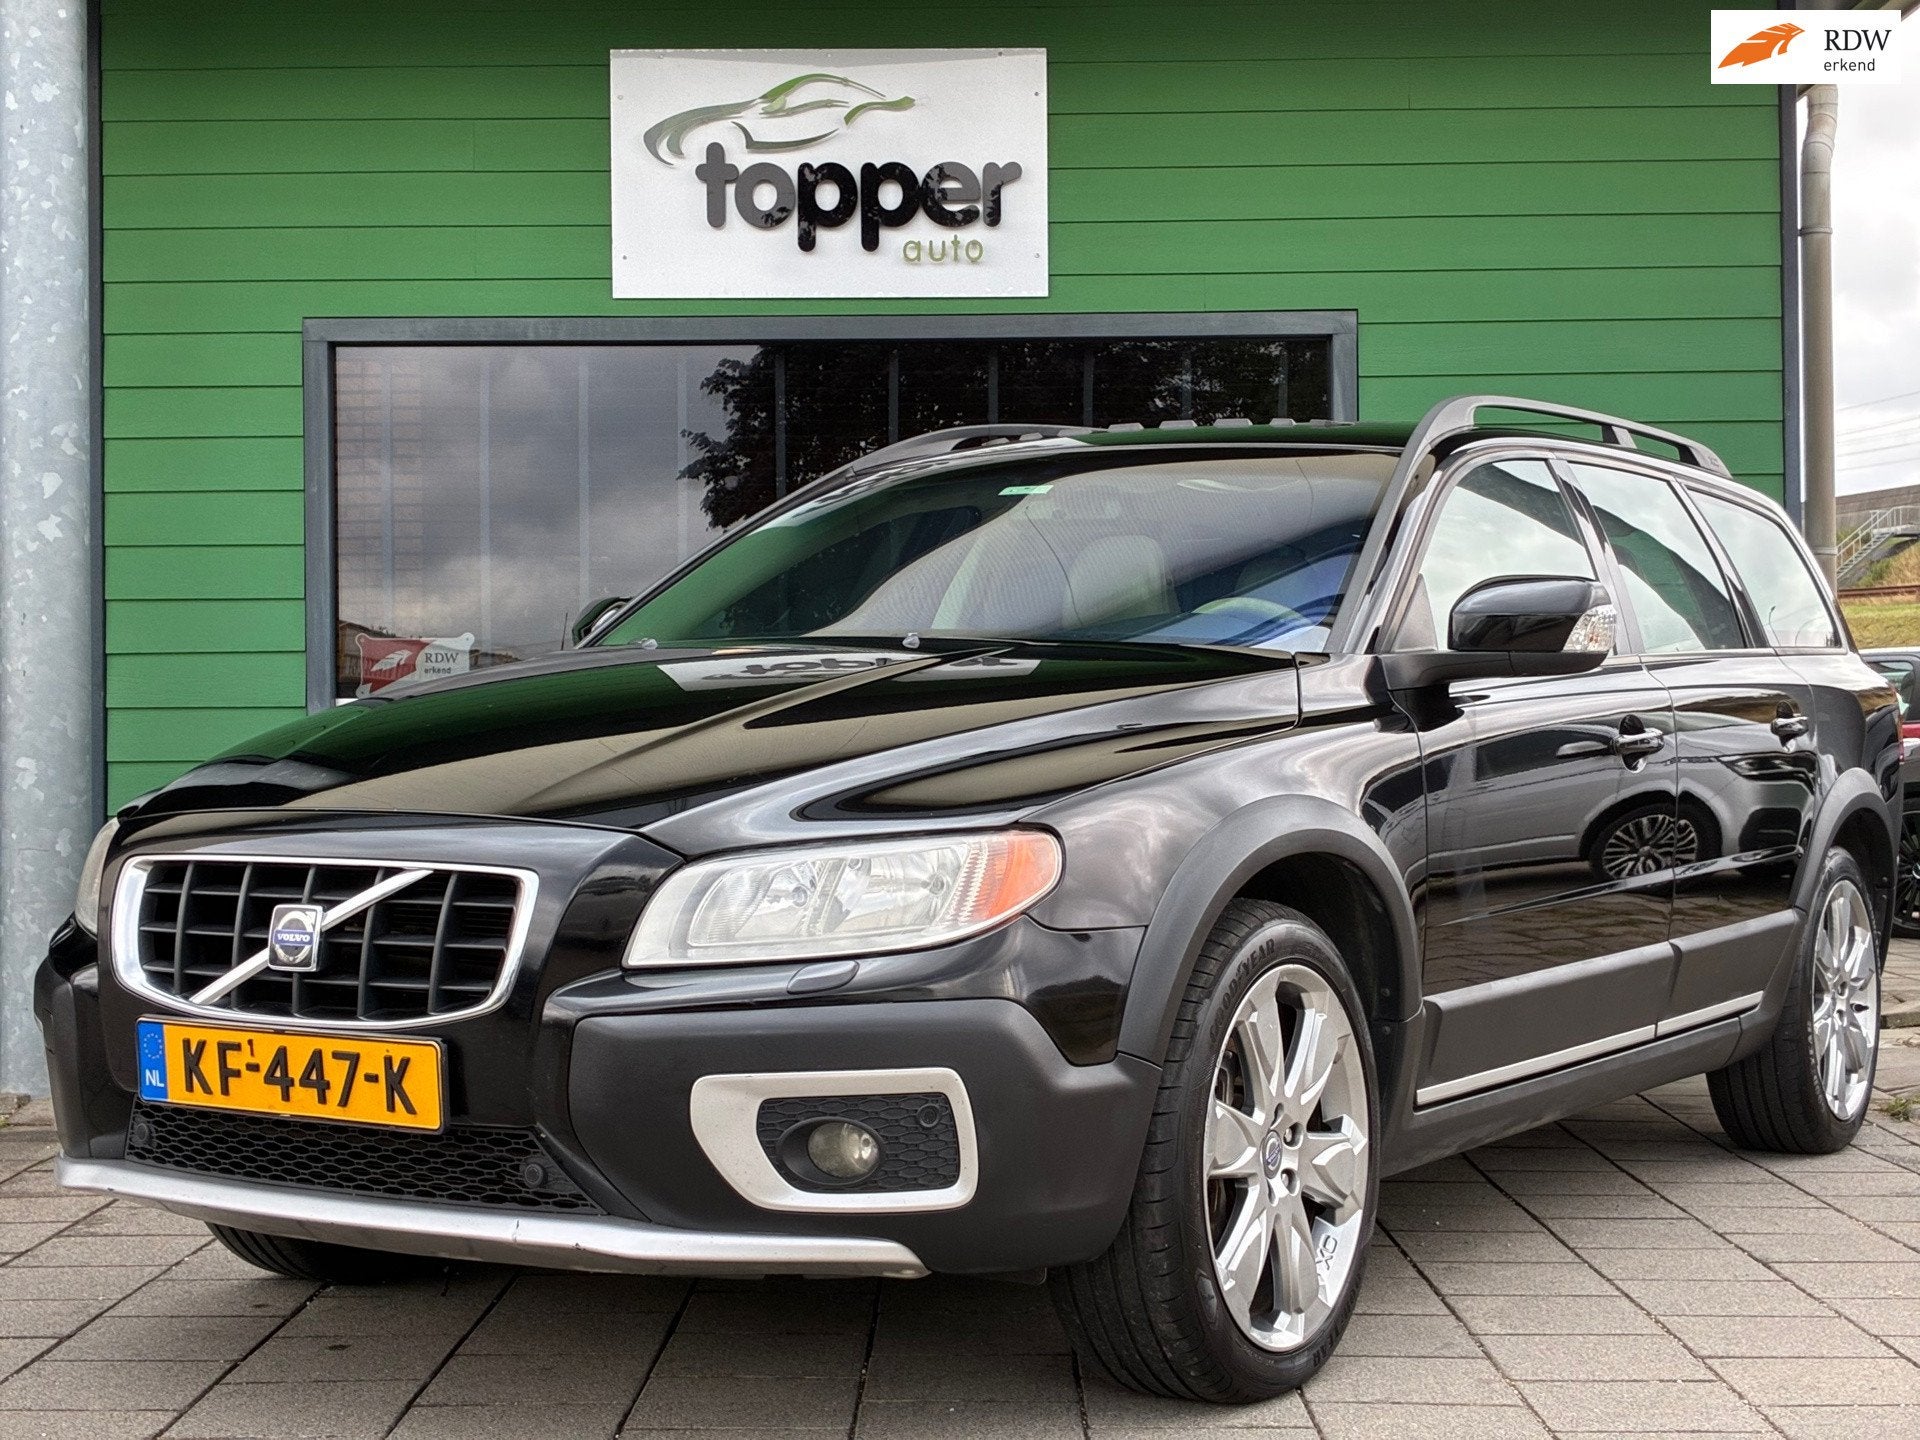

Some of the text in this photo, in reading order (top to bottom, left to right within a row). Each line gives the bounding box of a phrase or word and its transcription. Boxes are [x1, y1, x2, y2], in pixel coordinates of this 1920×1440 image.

[695, 141, 1023, 253] topper
[902, 234, 984, 262] auto
[424, 652, 459, 663] RDW
[424, 666, 451, 674] erkend
[277, 933, 311, 943] VOLVO
[145, 1069, 165, 1088] NL
[181, 1037, 418, 1116] KF-447-K
